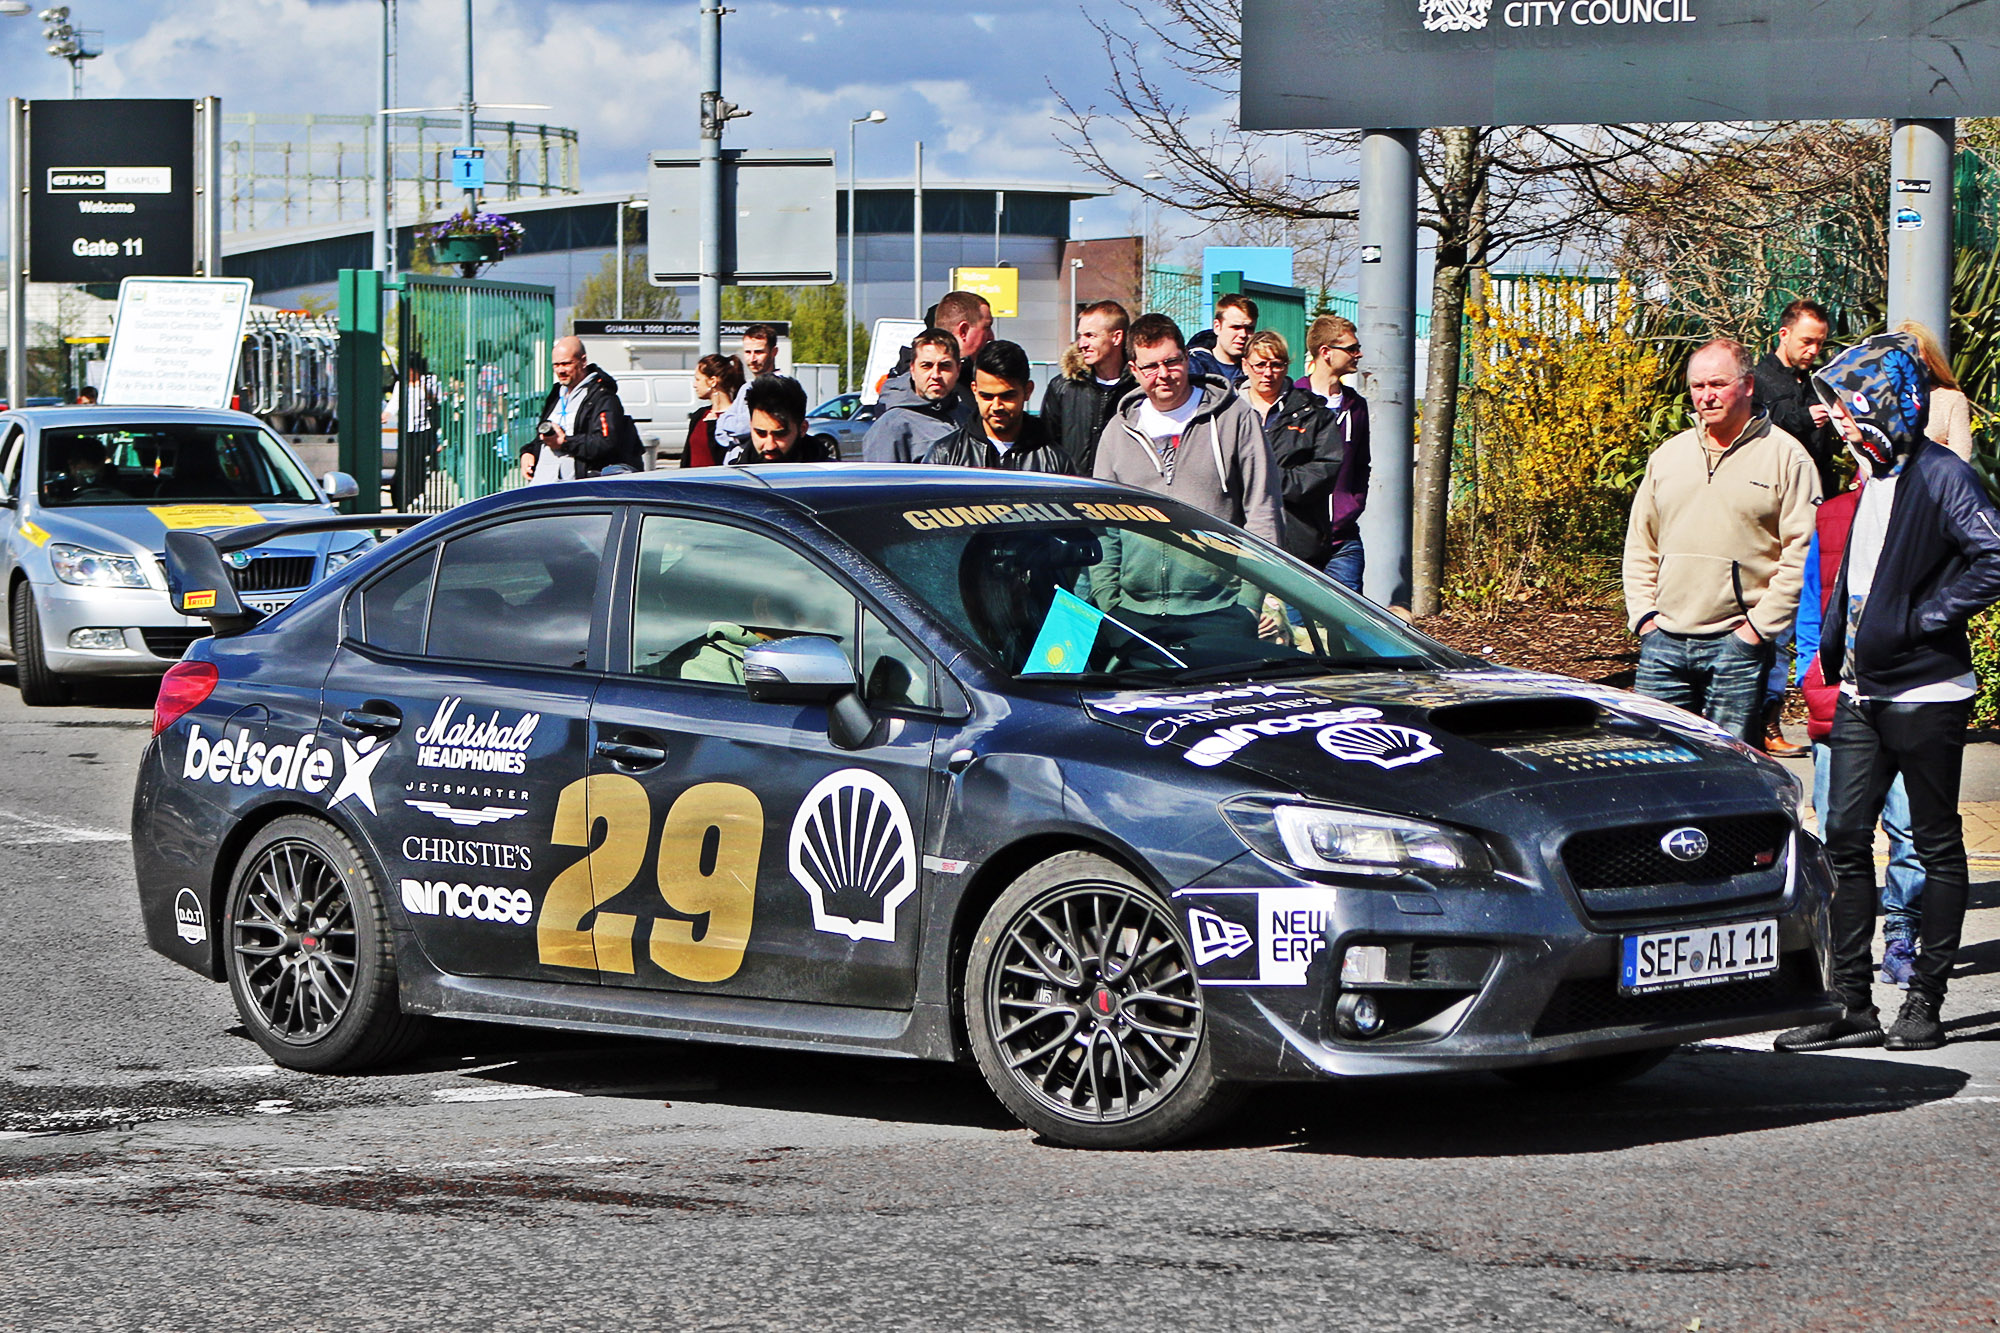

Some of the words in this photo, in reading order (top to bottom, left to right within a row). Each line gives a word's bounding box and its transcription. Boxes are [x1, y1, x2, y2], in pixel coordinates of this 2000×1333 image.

[1503, 1, 1565, 27] CITY
[1570, 0, 1696, 25] COUNCIL
[52, 174, 105, 186] ETIHAD
[116, 176, 160, 185] CAMPUS
[78, 200, 136, 214] Welcome
[72, 237, 119, 257] Gate
[122, 237, 143, 257] 11
[960, 271, 990, 281] Yellow
[182, 286, 216, 297] Parking
[979, 283, 1001, 293] Park
[142, 308, 184, 317] Customer
[187, 309, 220, 320] Parking
[159, 333, 193, 344] Parking
[605, 325, 643, 333] GUMBALL
[666, 325, 700, 333] OFFICIA
[154, 358, 189, 368] Parking
[902, 503, 1082, 531] GUMBALL
[1072, 502, 1171, 523] 3000
[415, 695, 541, 751] Marshall
[182, 724, 334, 793] betsafe
[417, 746, 527, 775] HEADPHONES
[405, 781, 529, 801] JETSMARTER
[402, 836, 532, 871] CHRISTIE'S
[537, 773, 764, 983] 29
[1272, 910, 1327, 935] NEW
[1639, 935, 1690, 978] SEF
[1707, 930, 1738, 970] AI
[1744, 925, 1775, 966] 11
[1626, 966, 1634, 978] D
